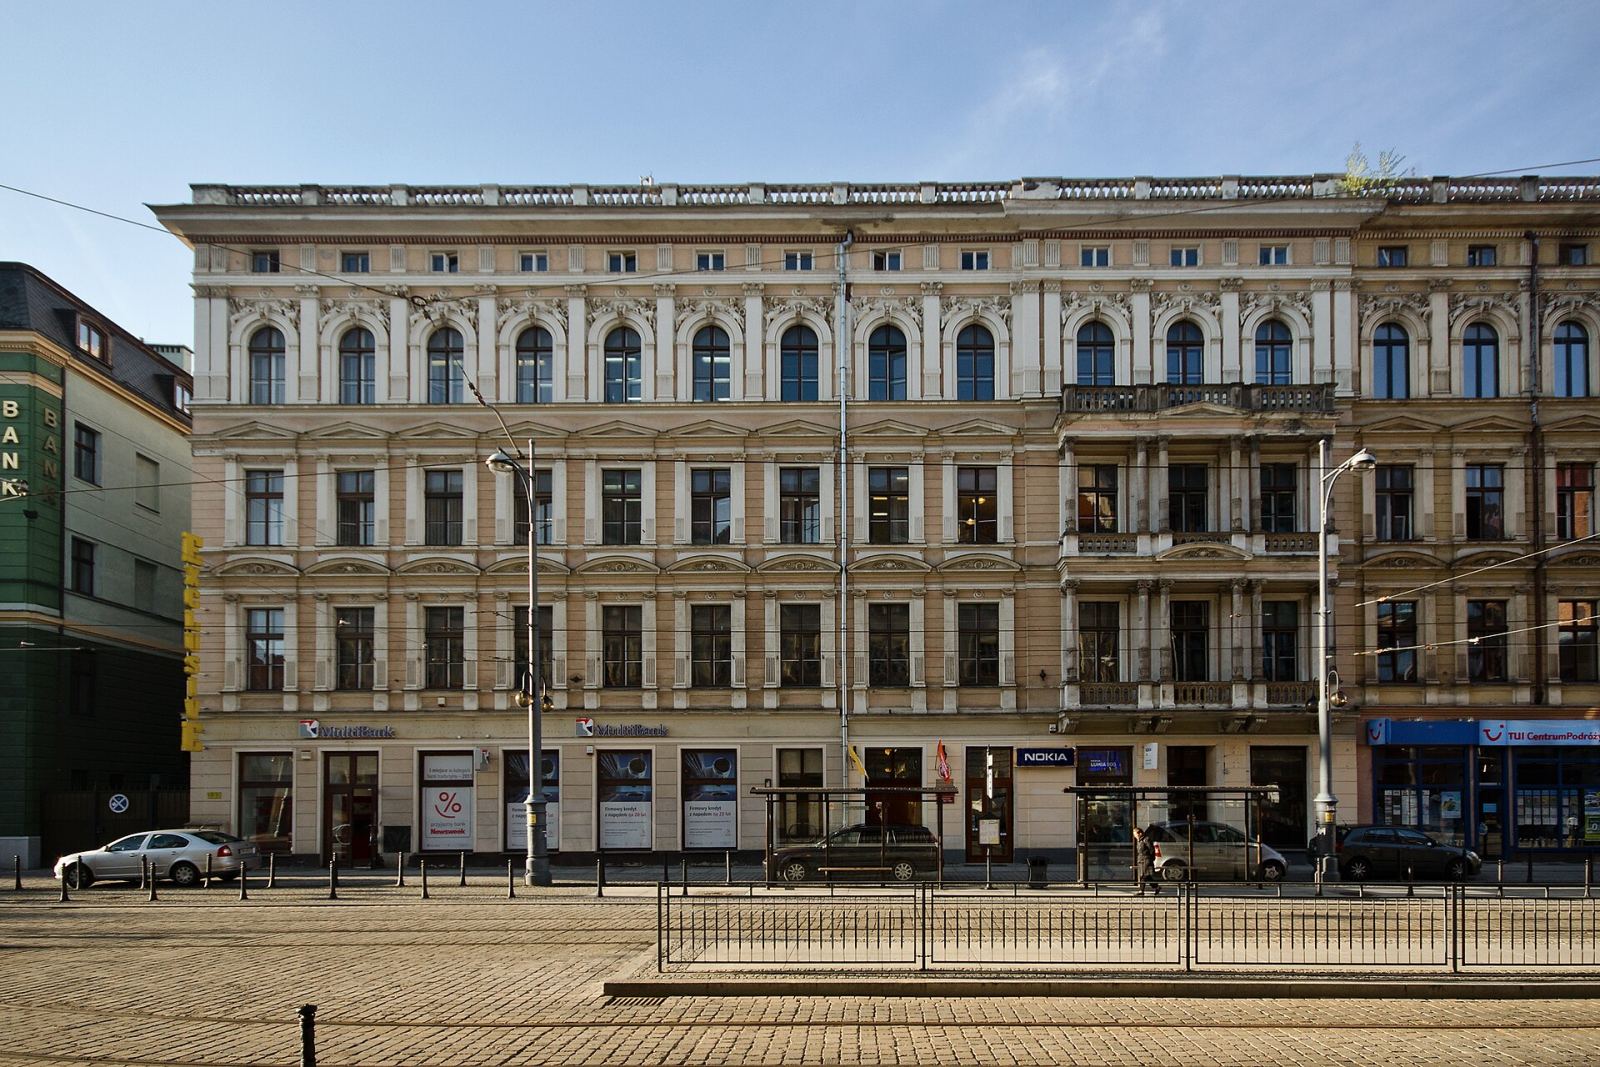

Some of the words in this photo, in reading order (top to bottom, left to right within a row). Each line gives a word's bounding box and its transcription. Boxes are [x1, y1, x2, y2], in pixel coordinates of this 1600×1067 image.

[2, 400, 19, 496] BANK
[320, 725, 395, 738] MultiBank
[597, 724, 668, 737] MultiBank
[1508, 732, 1525, 741] TUI
[1024, 752, 1068, 761] NOKIA
